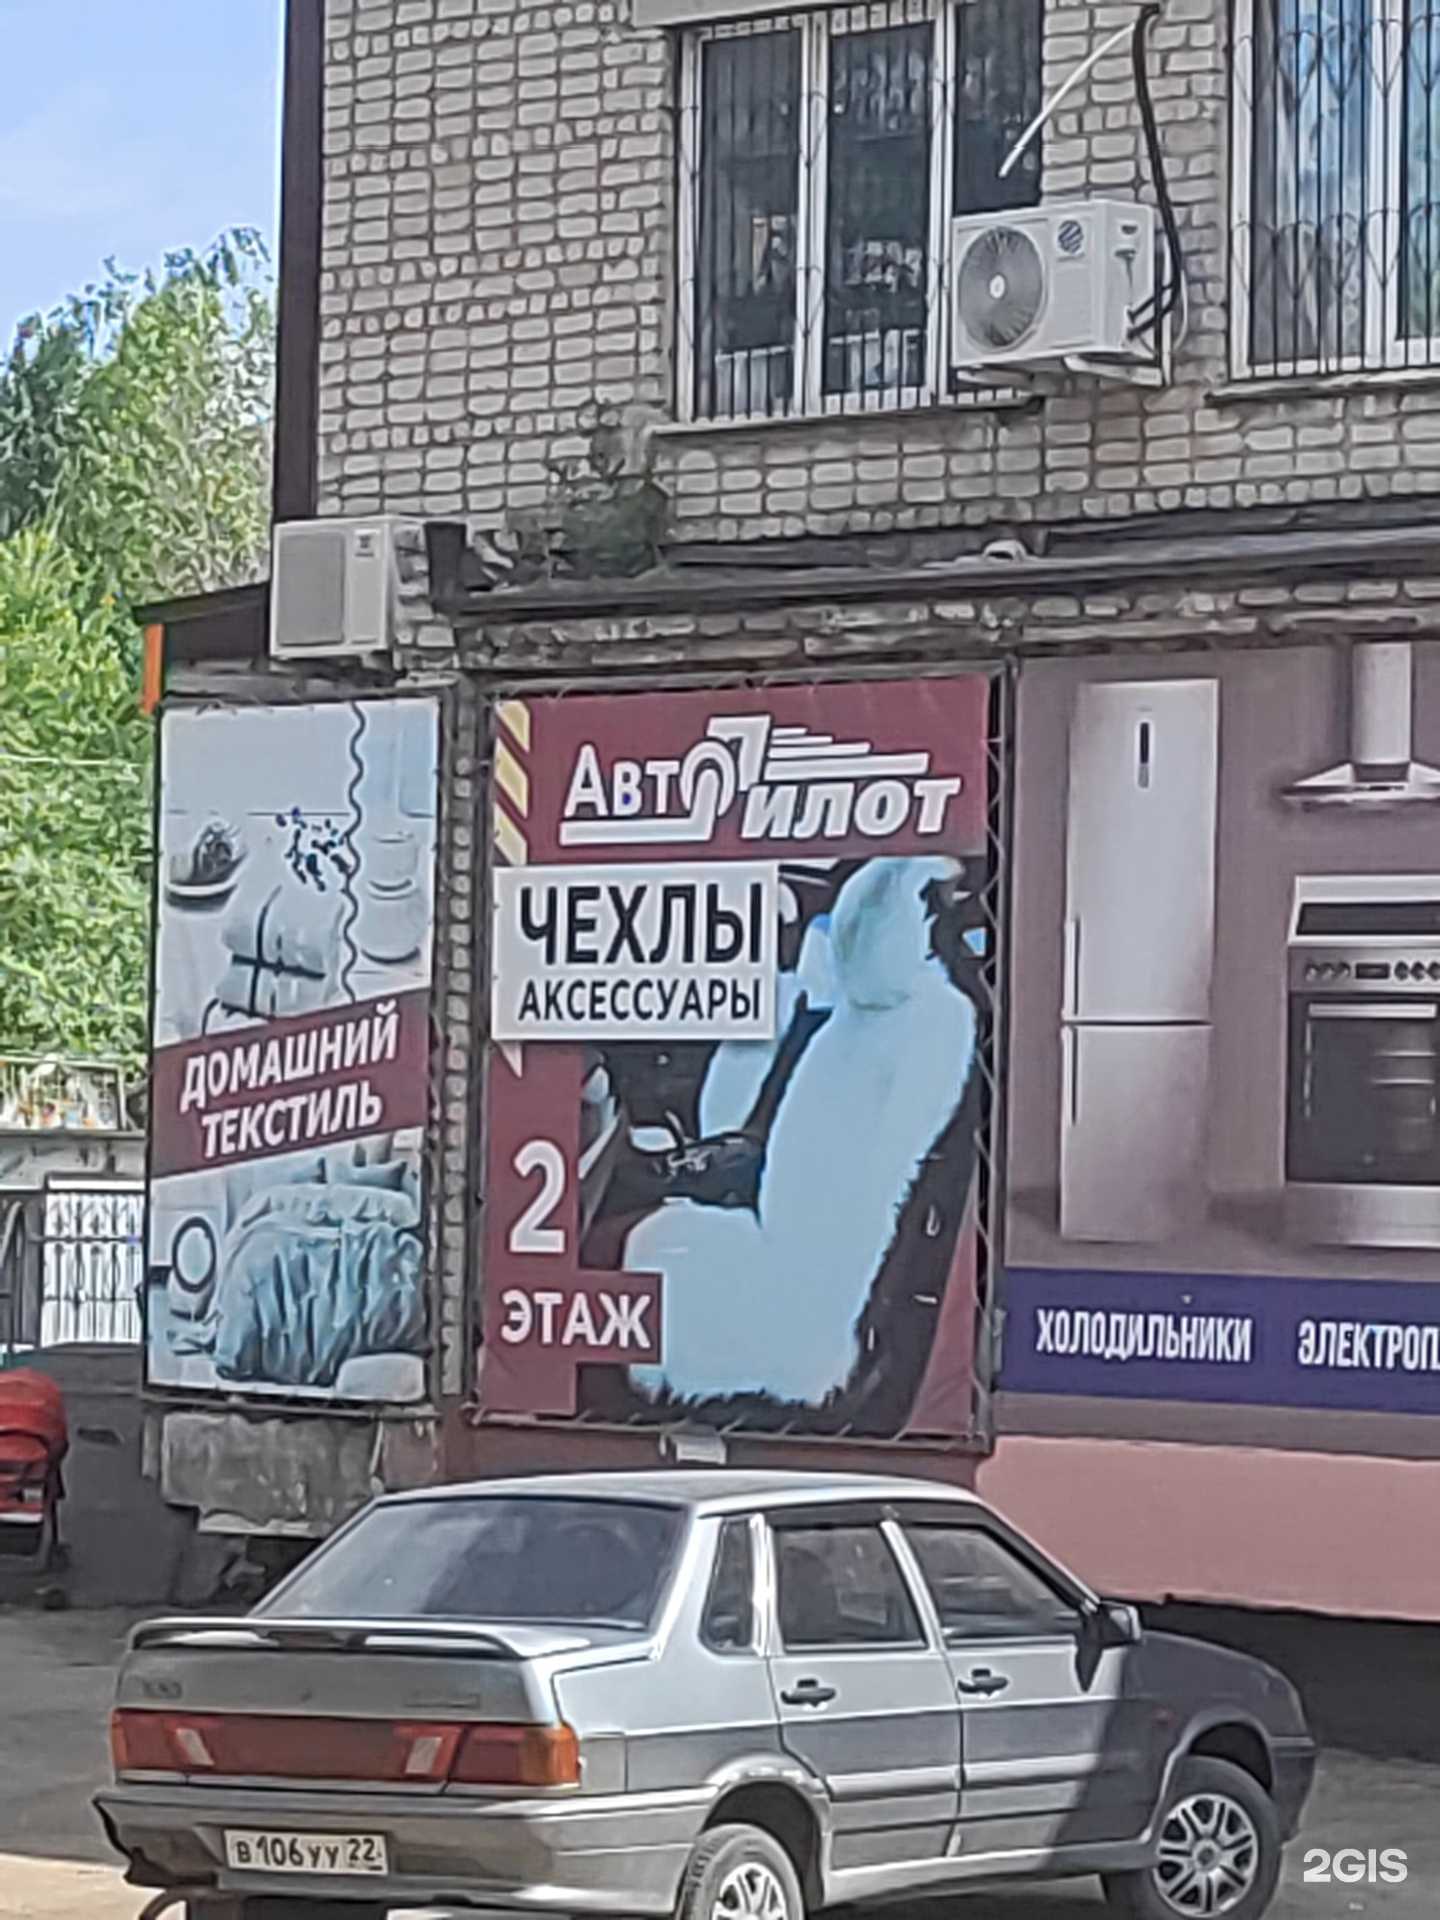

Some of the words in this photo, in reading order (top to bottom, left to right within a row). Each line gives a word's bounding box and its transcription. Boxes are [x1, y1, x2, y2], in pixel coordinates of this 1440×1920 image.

[520, 882, 763, 965] ЧЕХЛЫ
[518, 978, 761, 1021] АКСЕССУАРЫ
[179, 1000, 399, 1114] ДОМАШНИЙ
[202, 1080, 383, 1158] ТЕКСТИЛЬ
[509, 1139, 566, 1254] 2
[500, 1289, 651, 1348] ЭТАЖ
[1036, 1308, 1253, 1363] ХОЛОДИЛЬНИКИ
[1297, 1320, 1440, 1371] ЭЛЕКТРОП
